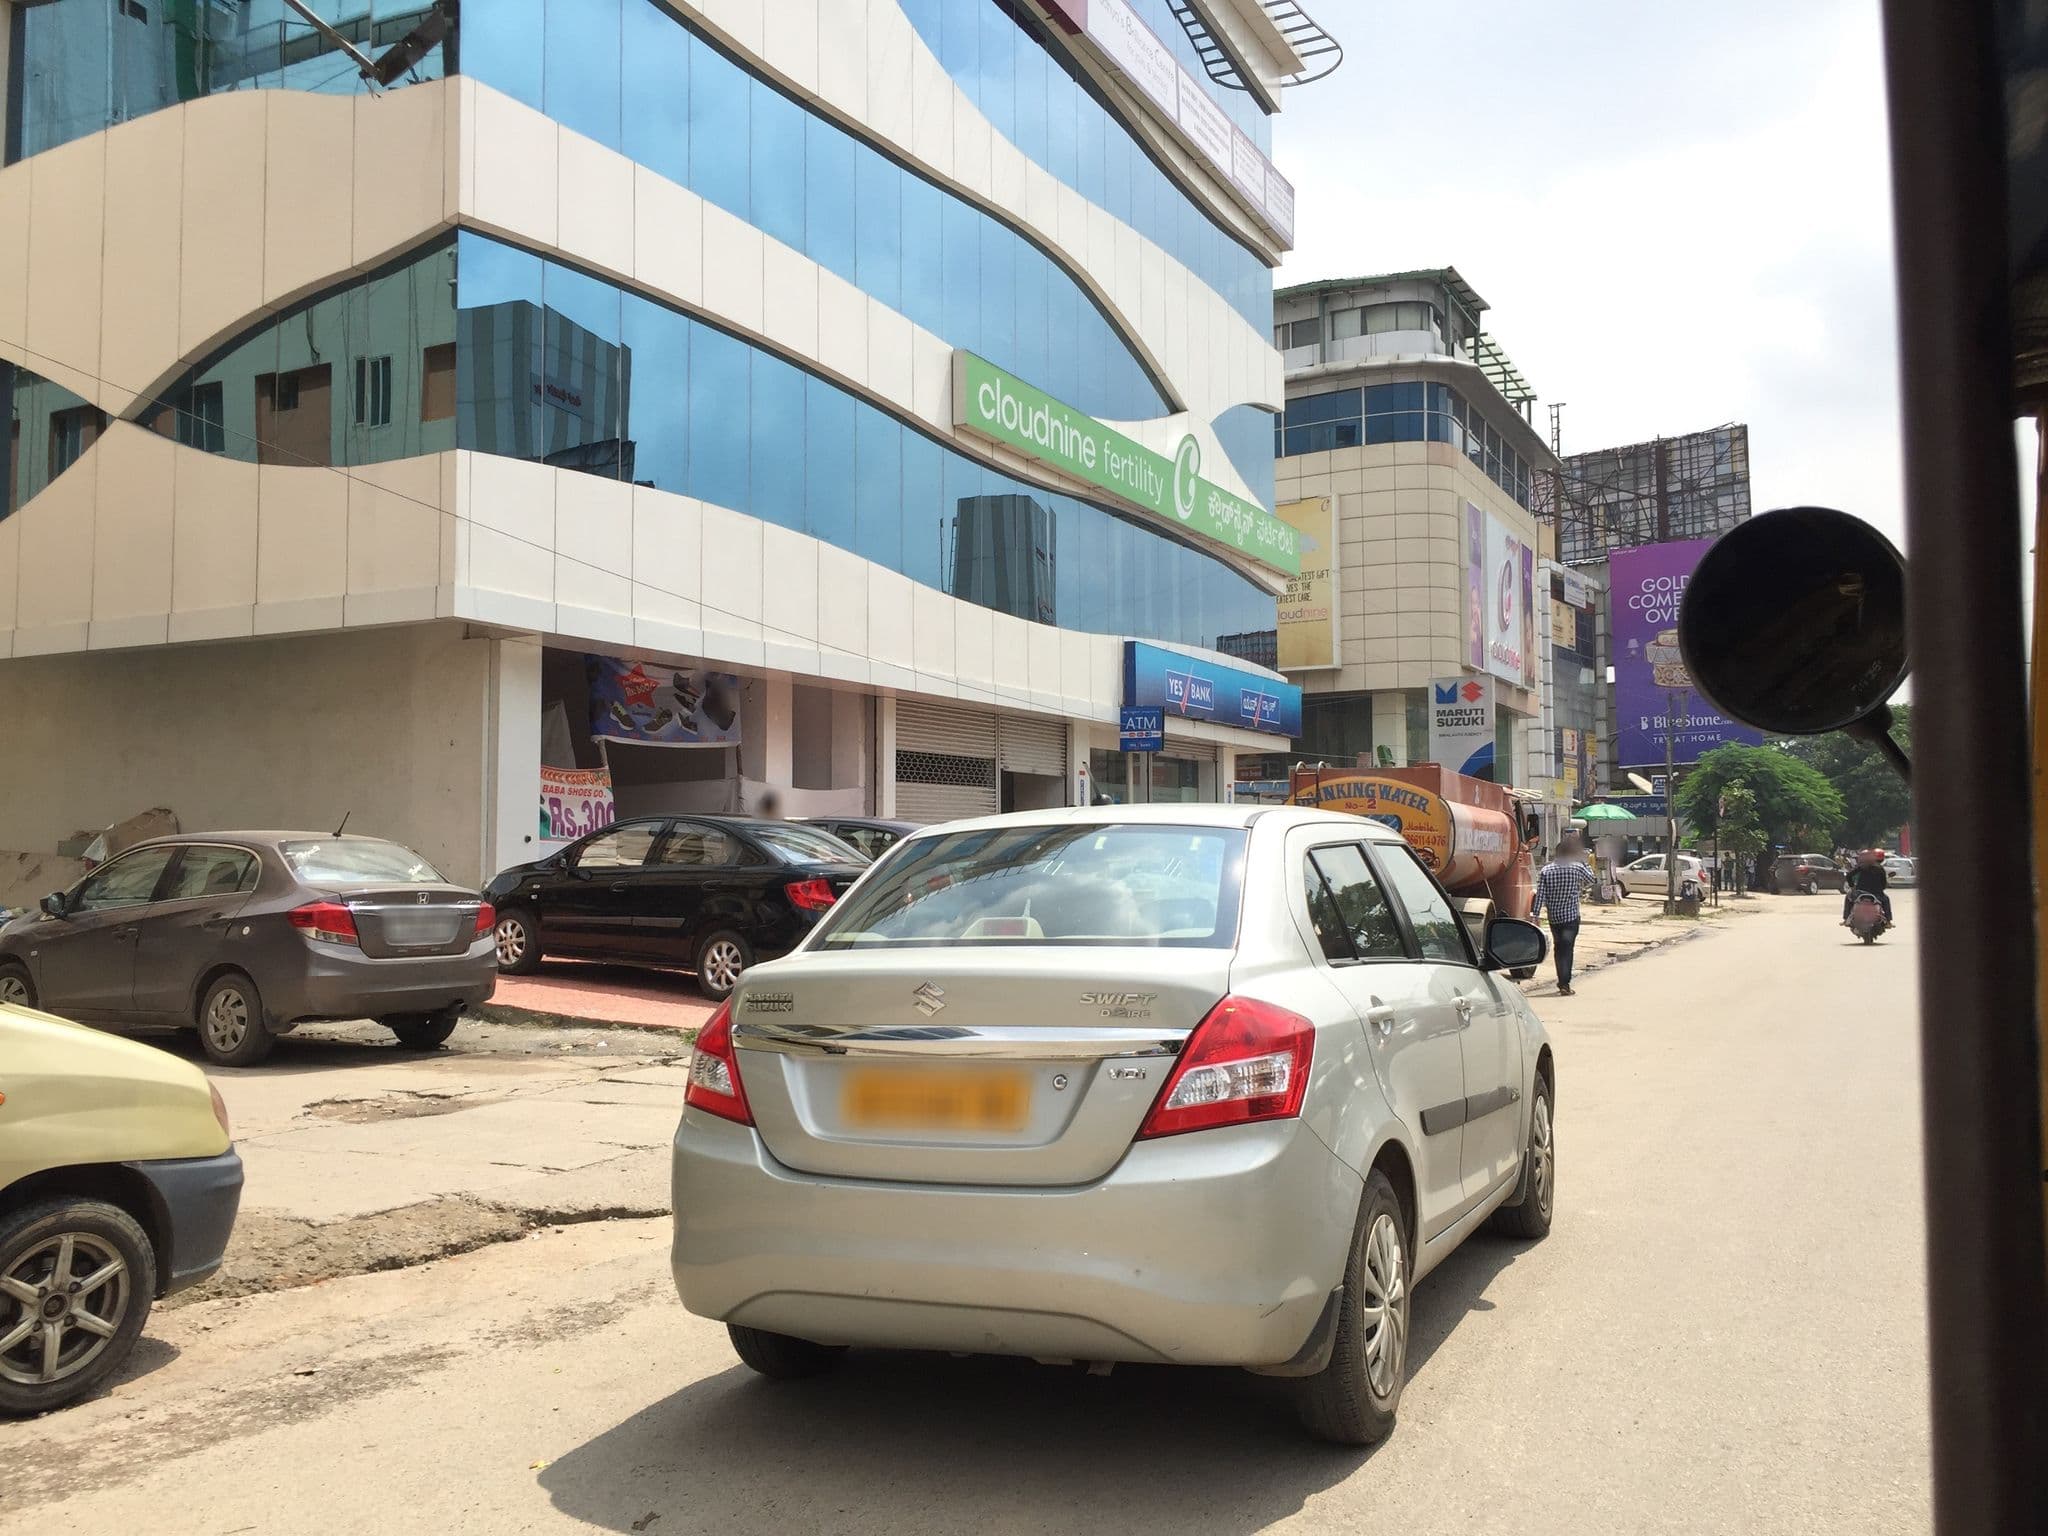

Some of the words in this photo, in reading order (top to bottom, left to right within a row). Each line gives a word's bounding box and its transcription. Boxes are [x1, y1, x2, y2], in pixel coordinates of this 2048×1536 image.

[978, 377, 1097, 469] cloudnine
[1103, 439, 1164, 505] fertility
[1641, 574, 1690, 593] GOLD
[1628, 591, 1682, 610] COME
[1278, 608, 1328, 621] loudnine
[1645, 607, 1680, 624] OVE
[1168, 678, 1183, 697] YES
[1190, 683, 1211, 702] BANK
[1436, 708, 1485, 718] MARUTI
[1125, 716, 1157, 730] ATM
[1436, 716, 1485, 728] SUZUKI
[1690, 733, 1721, 742] HOME
[542, 784, 565, 795] BABA
[567, 786, 593, 797] SHOES
[1367, 798, 1377, 810] 2
[1379, 783, 1431, 816] WATER
[744, 1001, 793, 1013] SUZUKI
